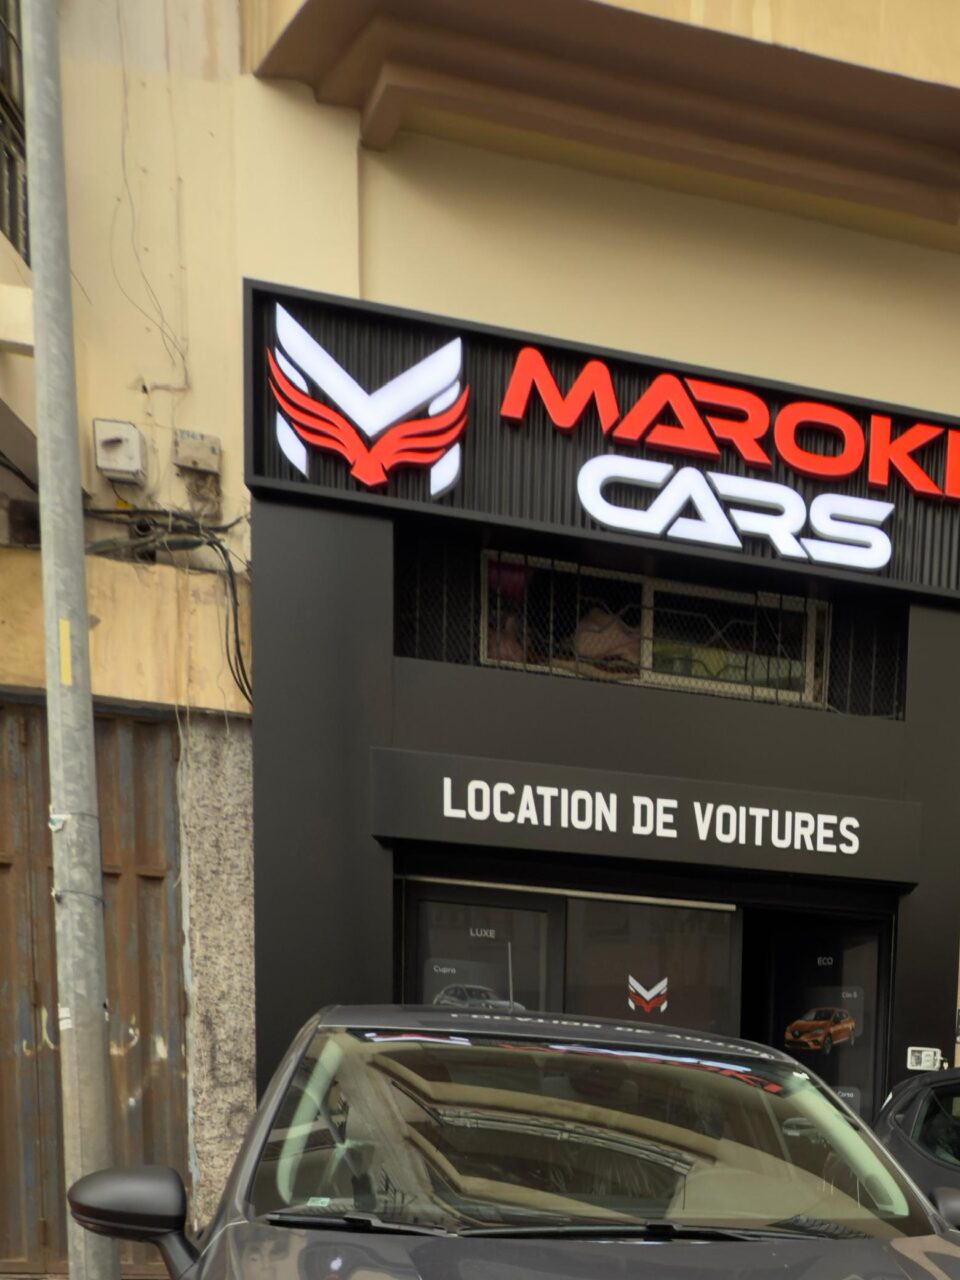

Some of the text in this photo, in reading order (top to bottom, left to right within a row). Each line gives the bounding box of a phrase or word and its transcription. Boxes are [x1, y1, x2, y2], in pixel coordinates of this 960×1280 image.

[577, 454, 895, 569] CARS
[443, 776, 860, 855] LOCATION DE VOITURES
[470, 928, 496, 938] LUXE
[817, 957, 834, 966] ECO
